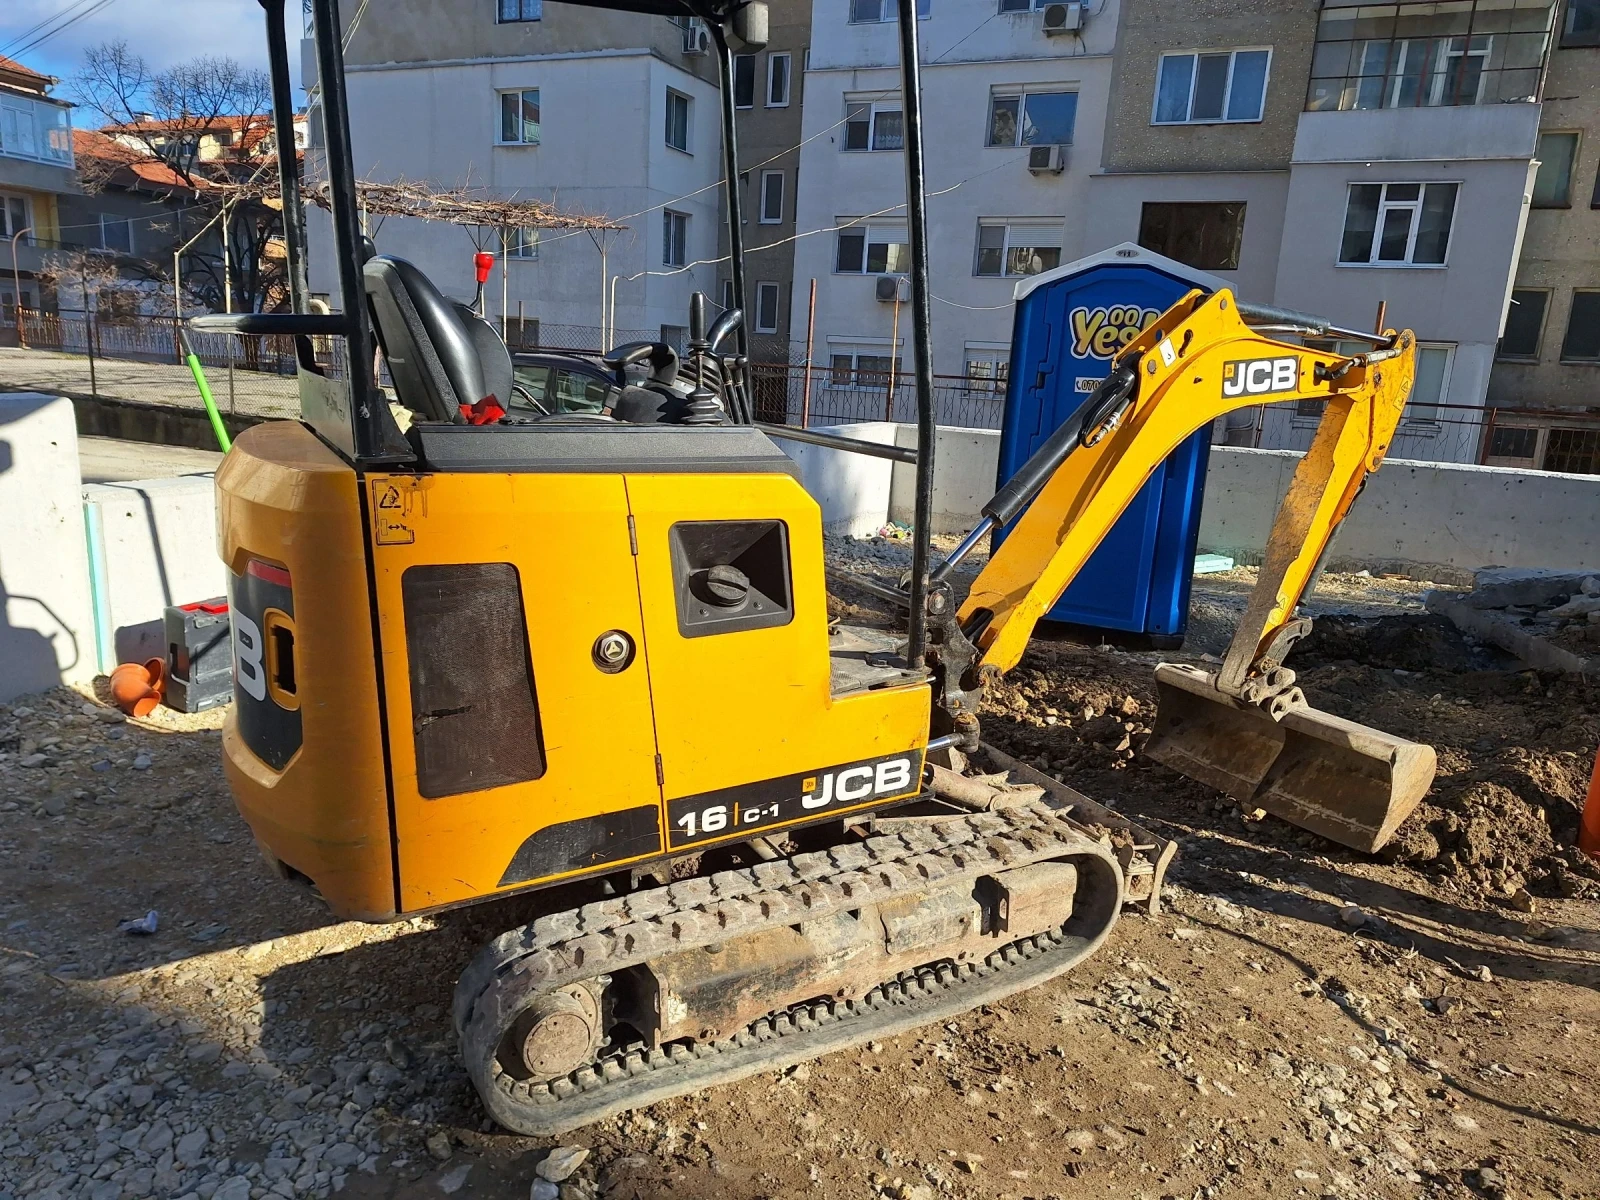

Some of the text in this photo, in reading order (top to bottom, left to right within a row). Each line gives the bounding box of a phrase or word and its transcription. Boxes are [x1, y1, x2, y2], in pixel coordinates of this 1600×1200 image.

[1082, 380, 1102, 391] 070
[1223, 358, 1297, 396] JCB
[801, 758, 911, 810] JCB
[677, 805, 727, 837] 16
